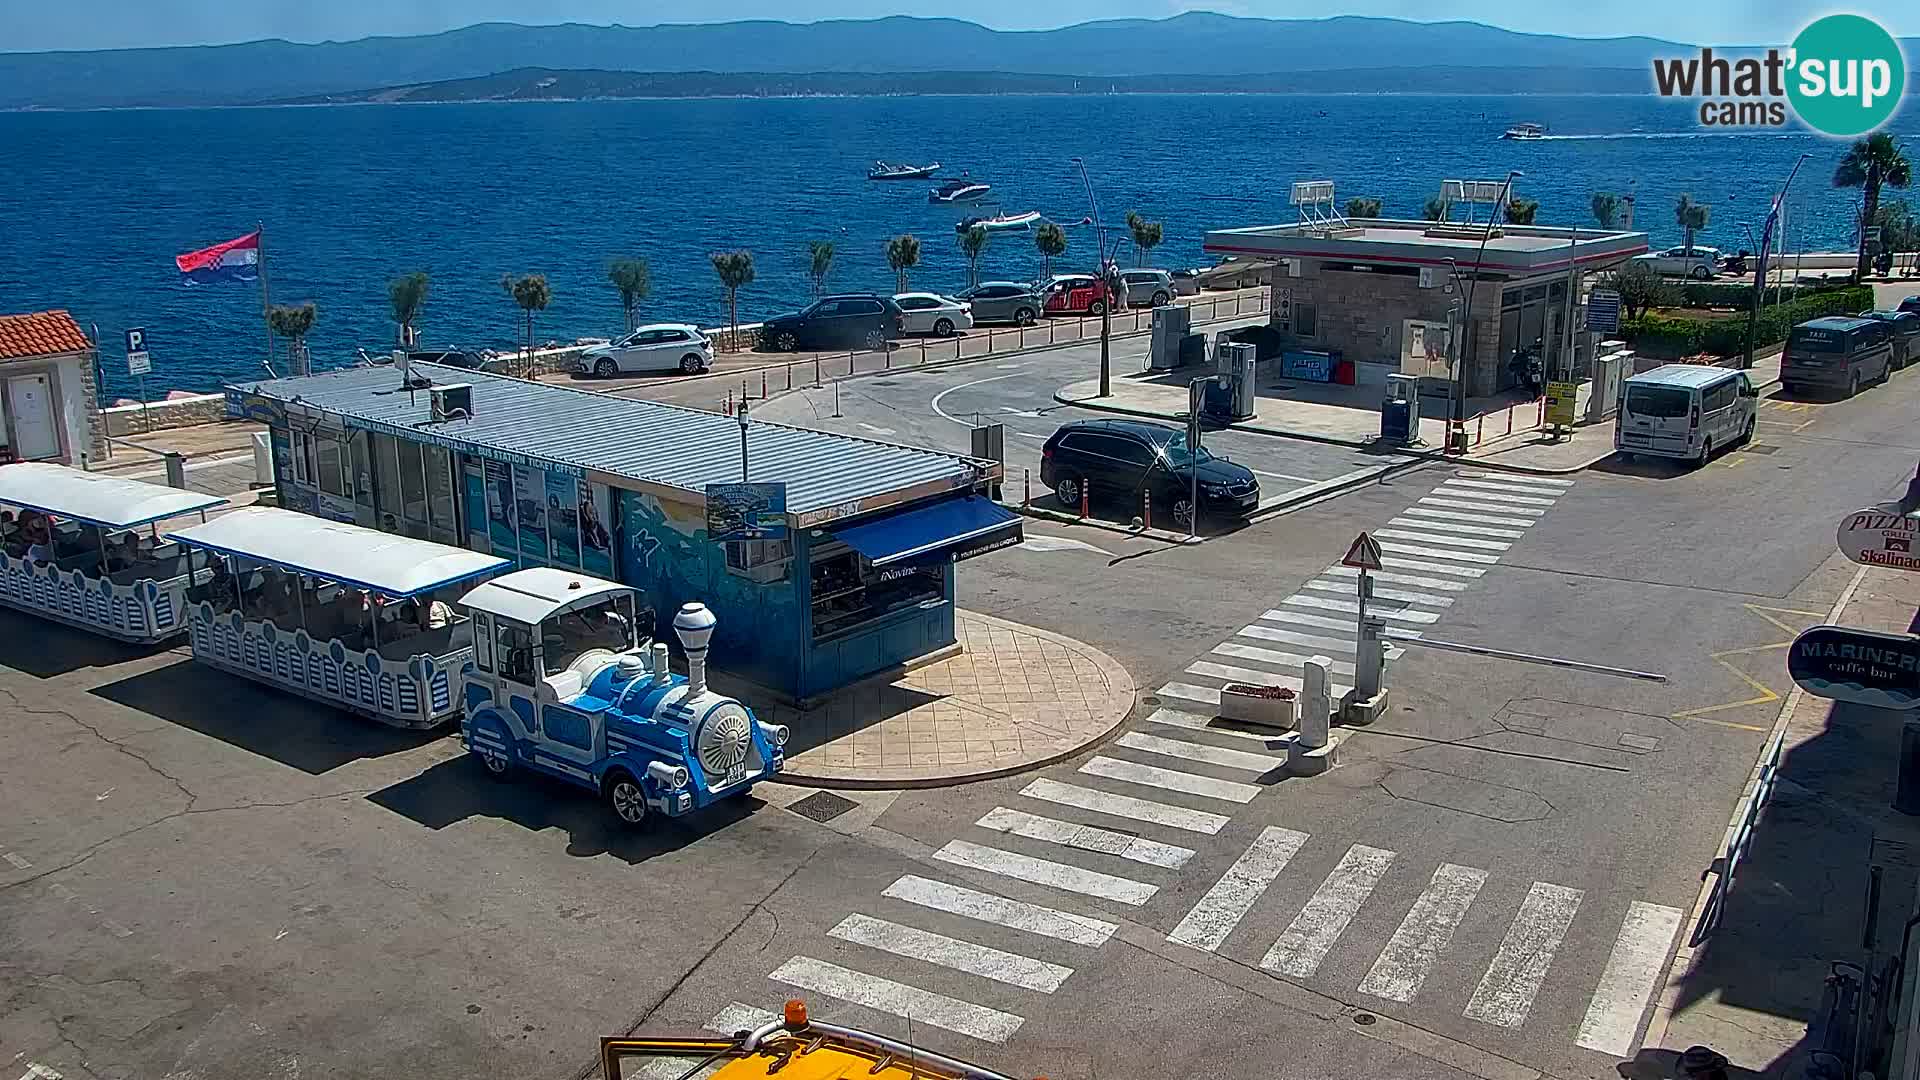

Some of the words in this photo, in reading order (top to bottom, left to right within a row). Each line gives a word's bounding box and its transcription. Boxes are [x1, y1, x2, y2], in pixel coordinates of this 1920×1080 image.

[130, 331, 142, 350] P
[1809, 331, 1826, 339] TAXI
[478, 446, 492, 457] BUS
[494, 450, 526, 464] STATION
[529, 458, 553, 472] TICKET
[556, 463, 581, 477] OFFICE
[1848, 515, 1920, 531] PIZZE
[881, 567, 917, 581] iNovine
[1871, 666, 1896, 679] bar
